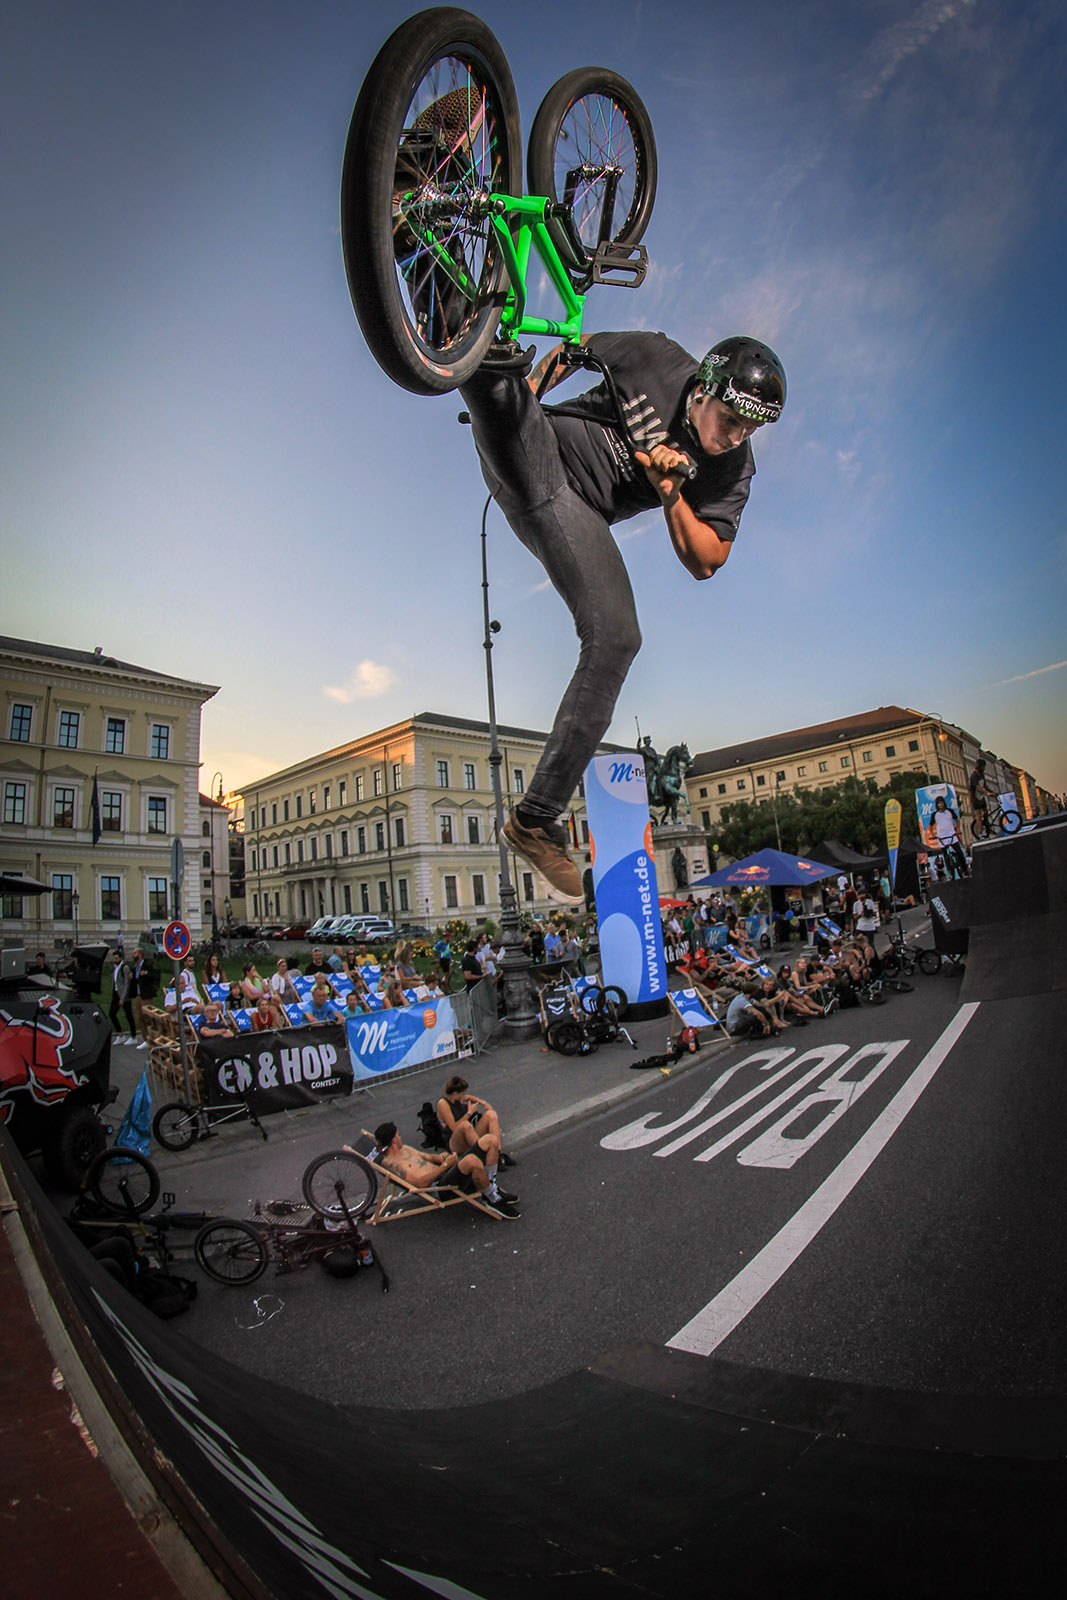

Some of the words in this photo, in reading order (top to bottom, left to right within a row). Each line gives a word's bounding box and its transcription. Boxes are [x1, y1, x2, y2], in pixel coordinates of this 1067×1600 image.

[634, 856, 661, 993] www.m-net.de
[258, 1051, 279, 1089] &
[280, 1043, 338, 1085] HOP
[310, 1078, 341, 1089] CONTEST
[600, 1043, 911, 1169] BUS
